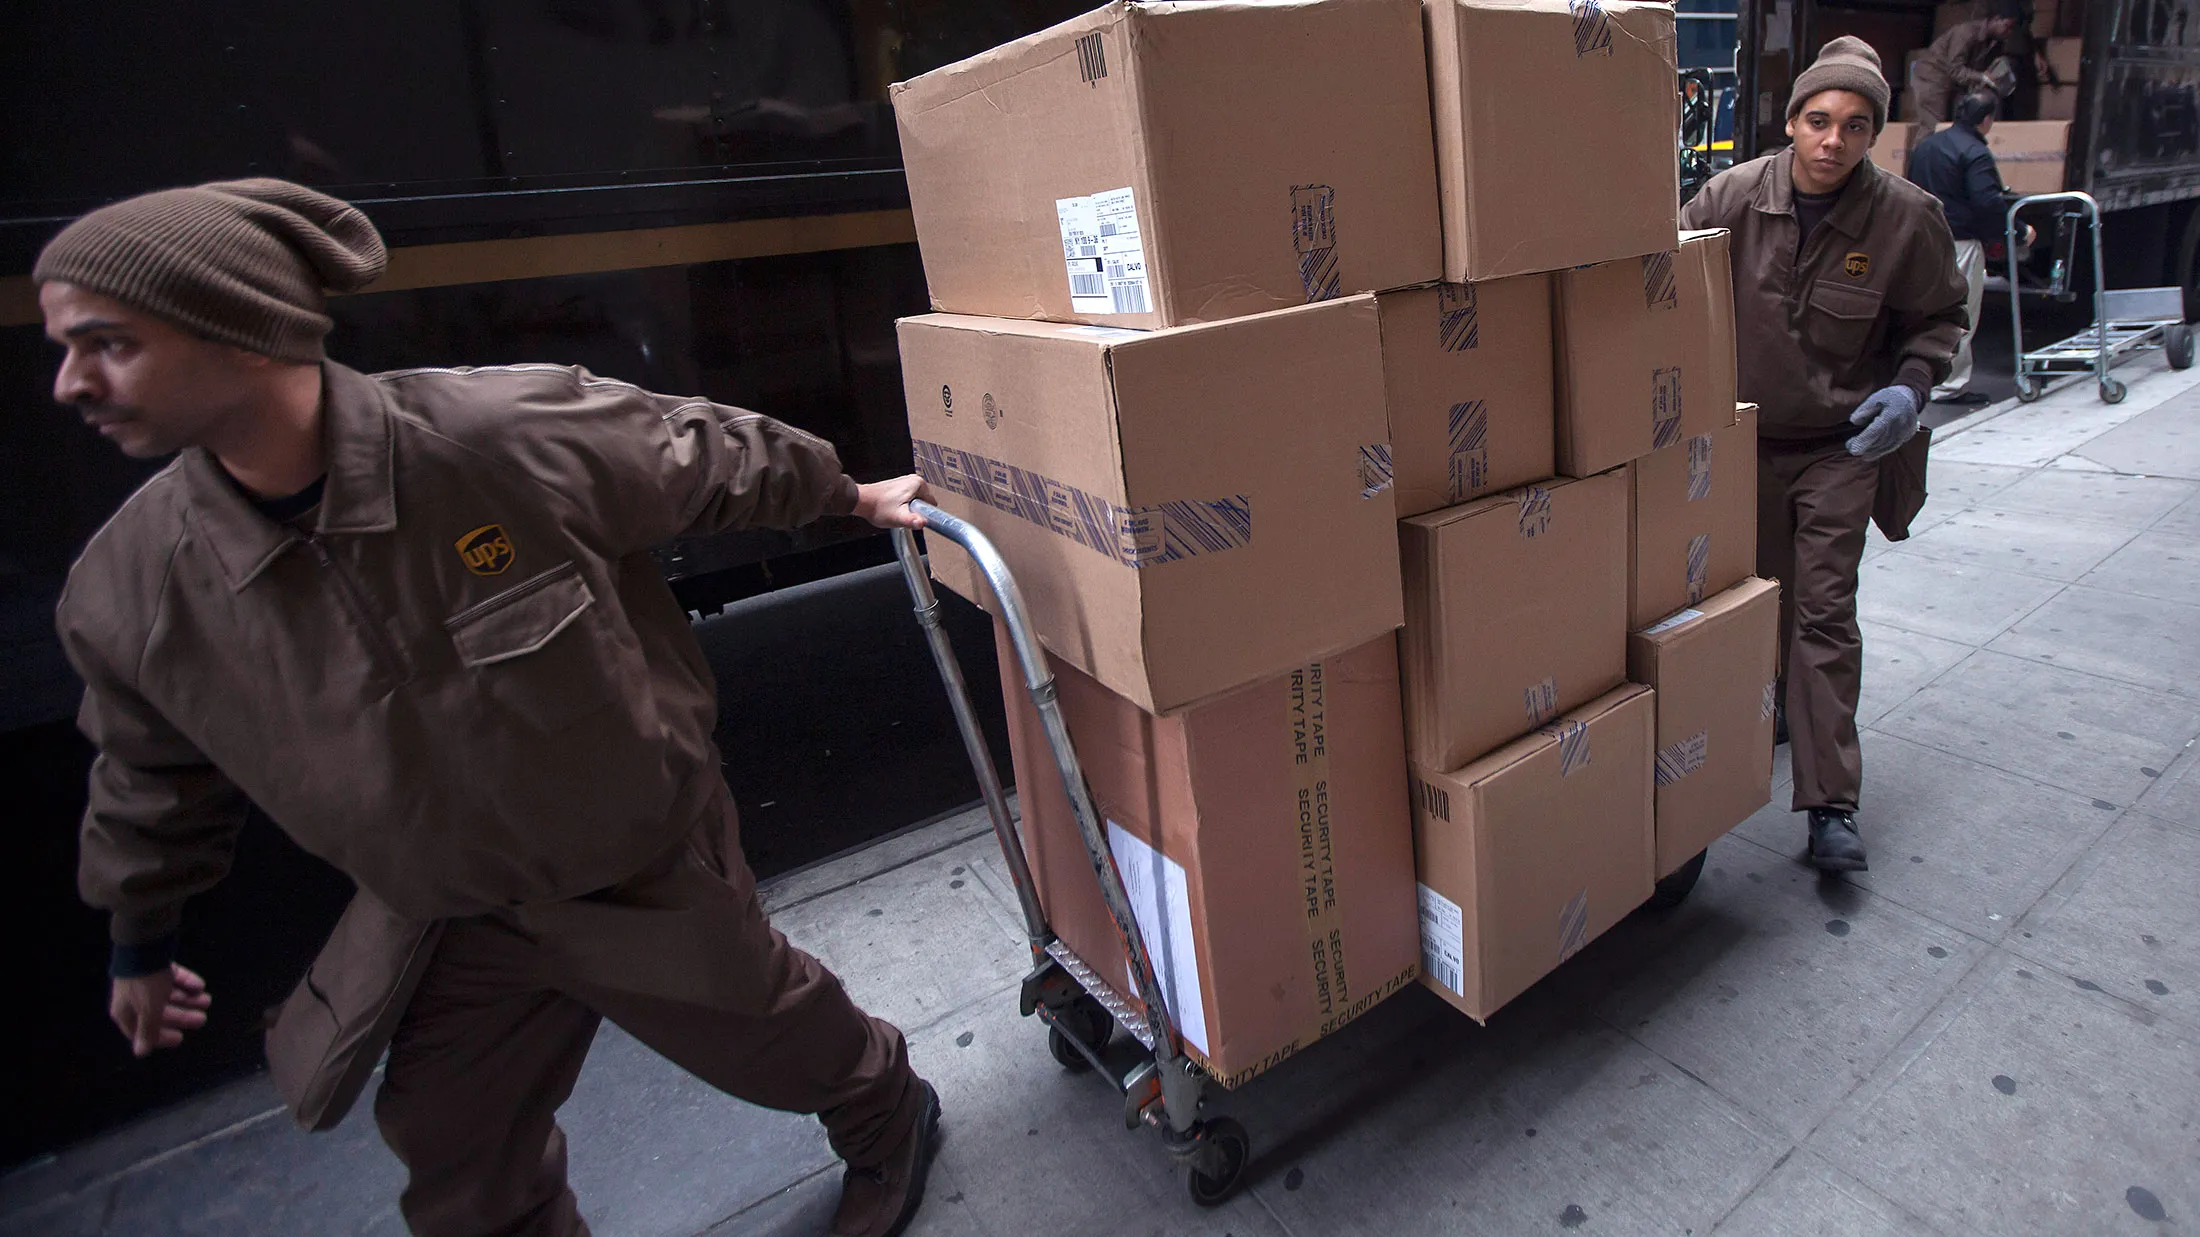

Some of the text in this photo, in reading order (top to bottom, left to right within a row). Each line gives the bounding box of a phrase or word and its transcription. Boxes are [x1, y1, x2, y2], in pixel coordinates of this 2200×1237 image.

[1847, 260, 1868, 275] ups
[464, 536, 509, 569] ups
[1294, 718, 1307, 765] TAPE
[1312, 711, 1325, 757] TAPE
[1298, 788, 1315, 870] SECURITY
[1316, 781, 1331, 861] SECURITY
[1304, 875, 1319, 918] TAPE
[1322, 866, 1336, 909] TAPE
[1312, 939, 1332, 1015] SECURITY
[1329, 928, 1348, 1003] SECURITY
[1263, 1039, 1300, 1070] TAPE
[1320, 985, 1382, 1038] SECURITY
[1386, 963, 1416, 993] TAPE
